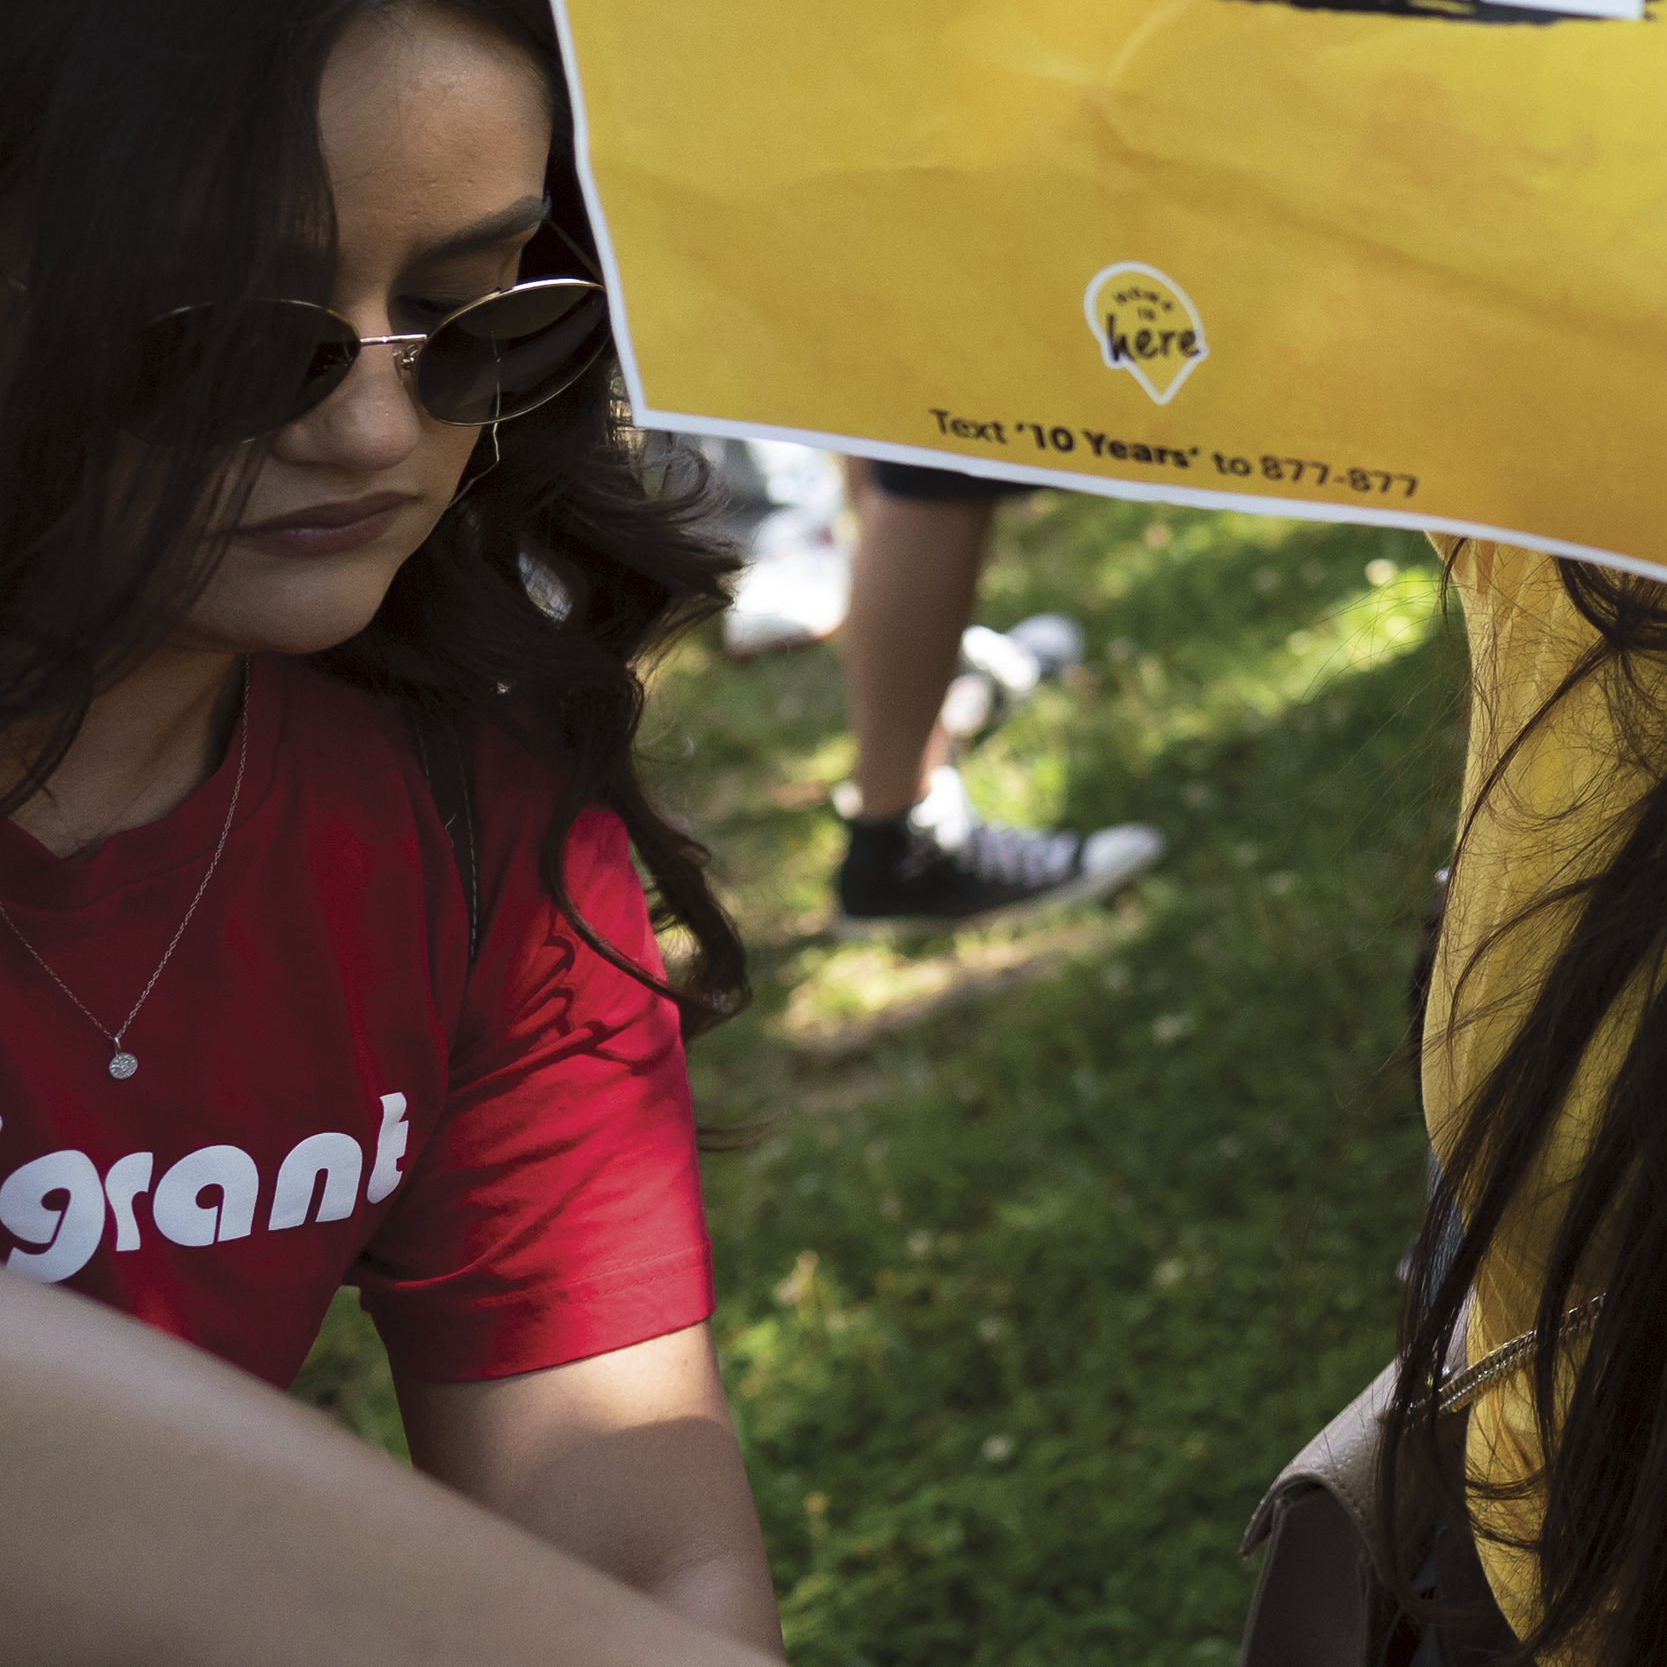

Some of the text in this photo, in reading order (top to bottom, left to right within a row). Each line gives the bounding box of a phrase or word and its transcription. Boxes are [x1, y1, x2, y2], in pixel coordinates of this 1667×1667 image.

[1106, 312, 1200, 363] here
[929, 408, 1007, 445] Text
[1211, 450, 1252, 478] to
[1259, 454, 1419, 500] 877-877
